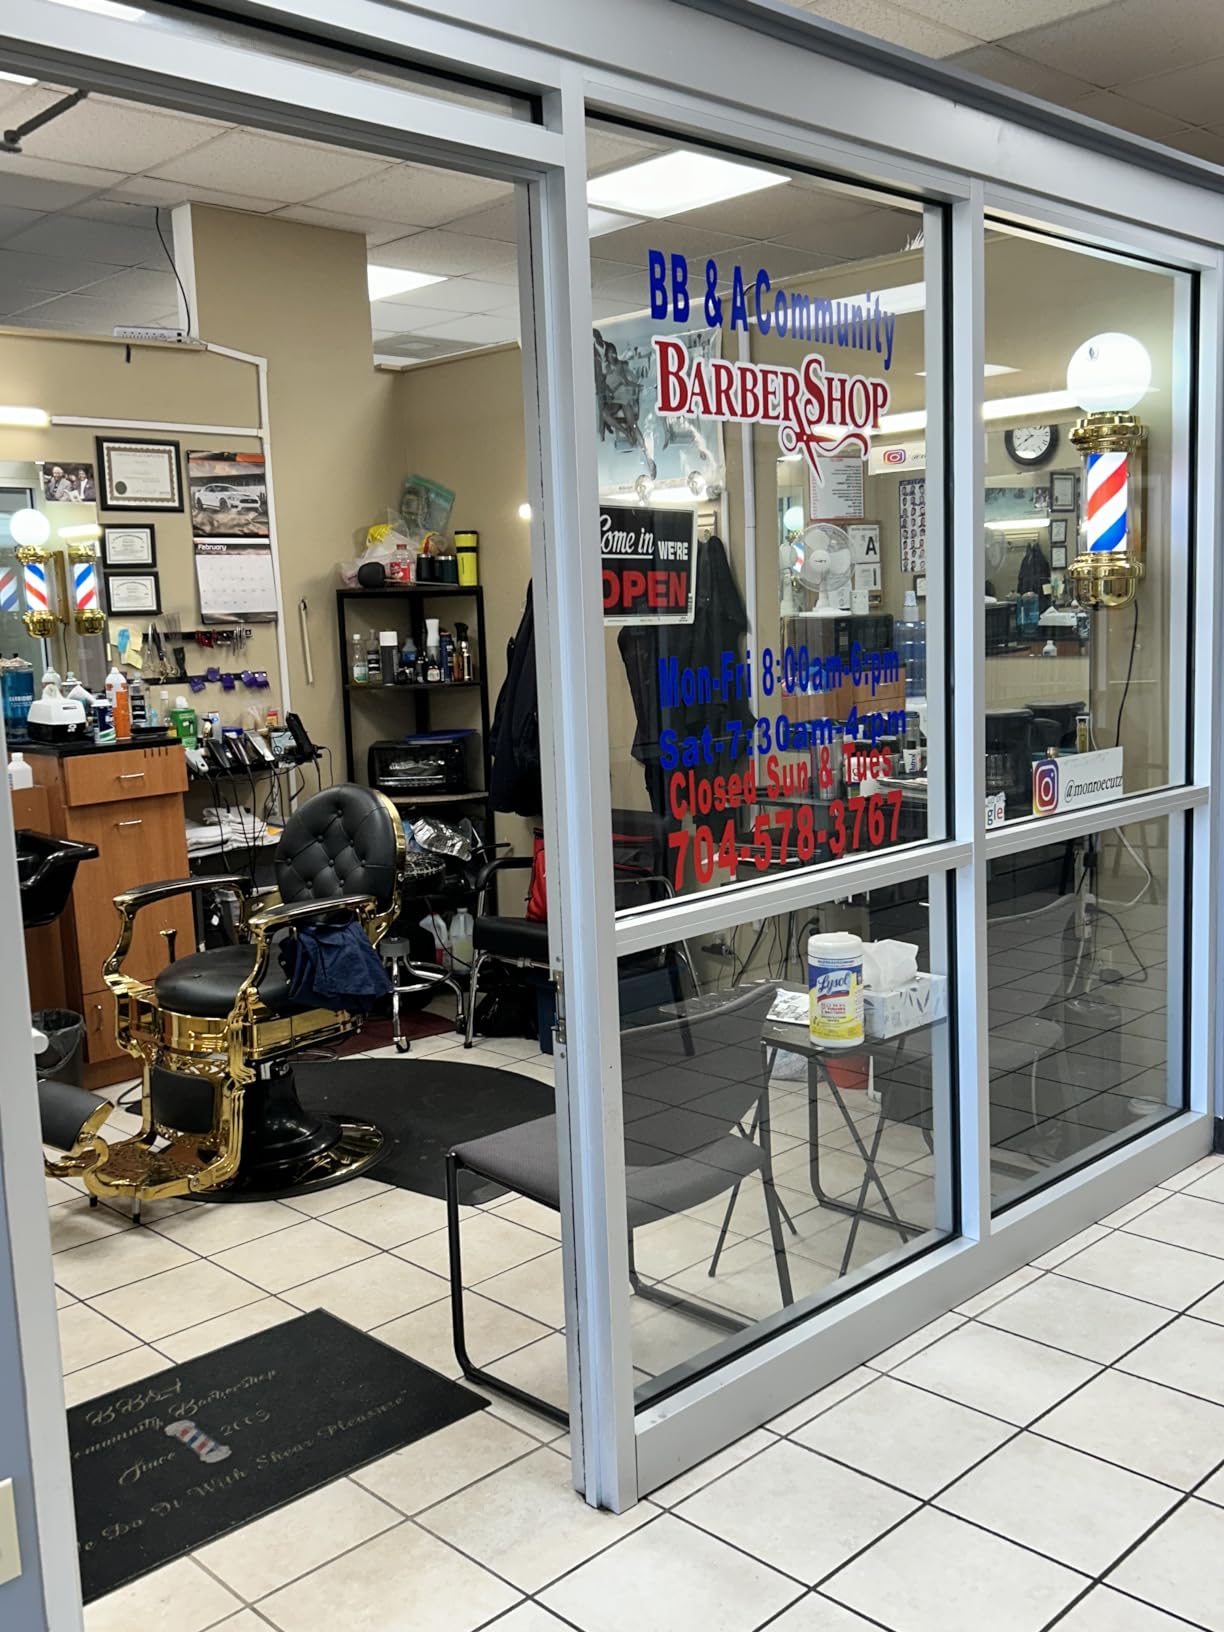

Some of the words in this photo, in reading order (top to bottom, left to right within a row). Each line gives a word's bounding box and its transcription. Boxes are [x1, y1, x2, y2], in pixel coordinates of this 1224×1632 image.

[648, 249, 690, 323] BB
[704, 259, 723, 328] &
[730, 265, 749, 332] A
[756, 268, 896, 370] Community
[197, 544, 227, 552] February
[638, 528, 654, 553] in
[658, 541, 688, 560] WE'RE
[602, 569, 687, 608] OPEN
[658, 650, 752, 709] Mon-Fri
[670, 759, 756, 820] Closed
[766, 754, 808, 800] Sun
[818, 746, 833, 789] &
[841, 742, 892, 785] Tues
[668, 789, 903, 892] 704-578-3767
[818, 972, 851, 993] Lysol
